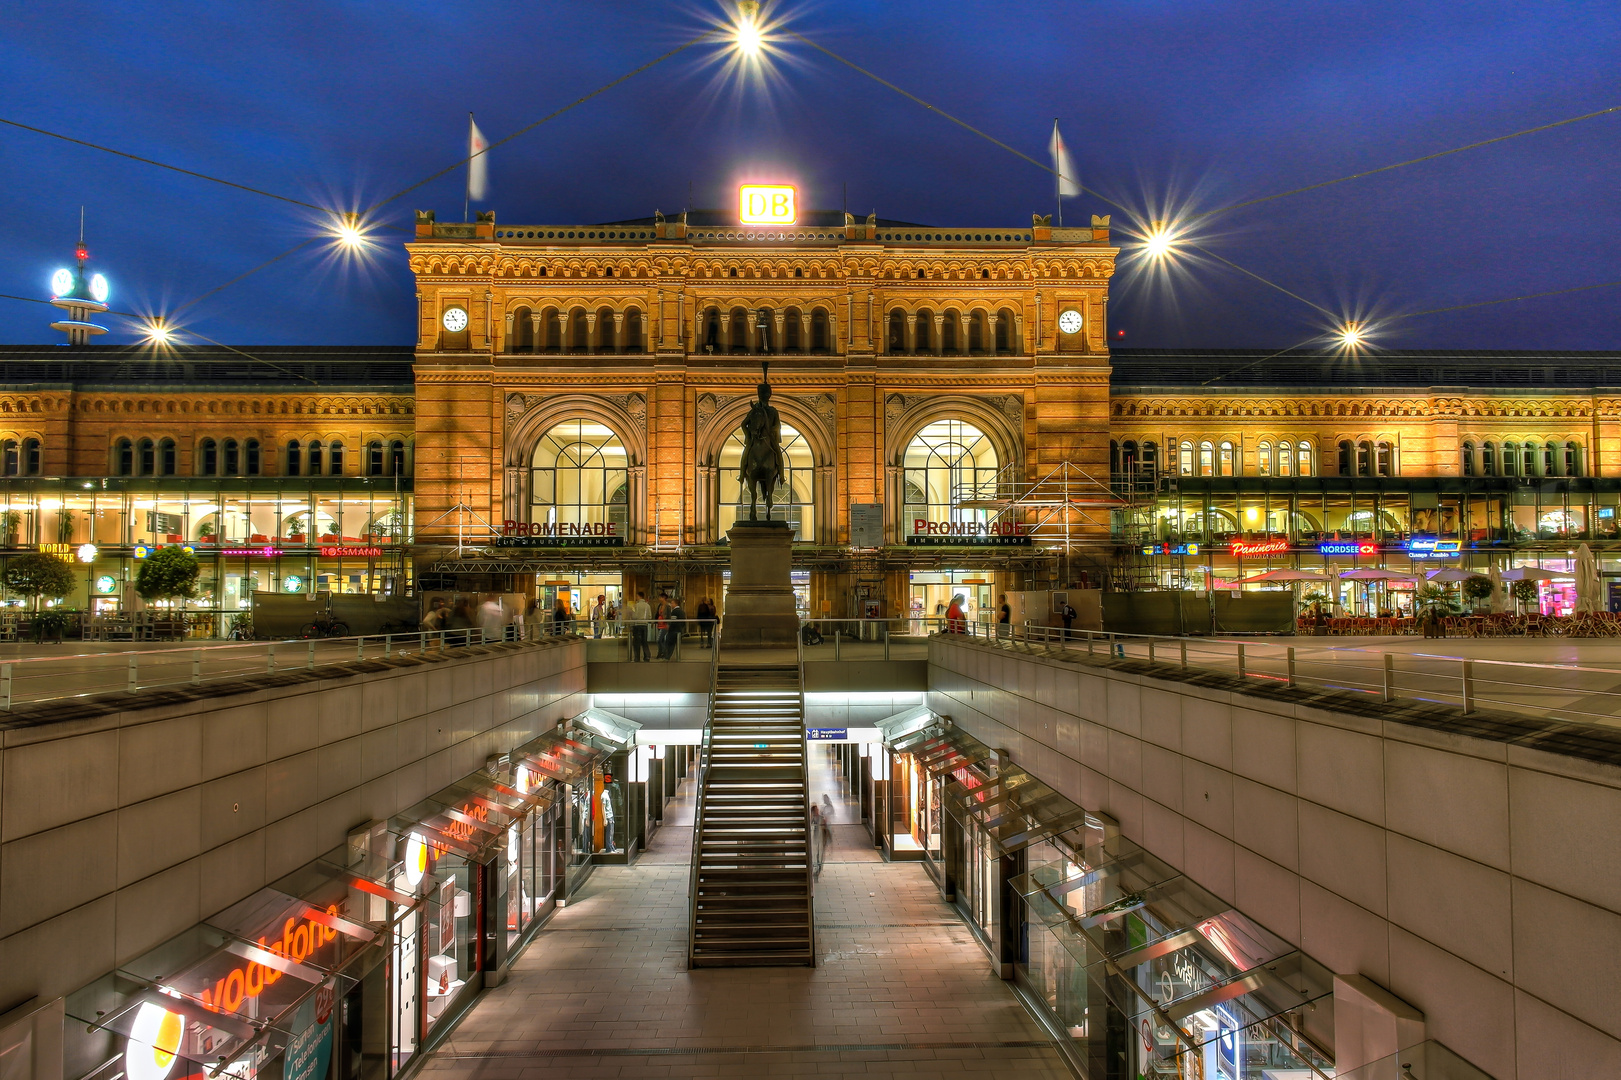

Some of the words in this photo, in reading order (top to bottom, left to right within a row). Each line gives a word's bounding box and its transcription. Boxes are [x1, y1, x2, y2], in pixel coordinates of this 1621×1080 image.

[748, 193, 789, 217] DB
[504, 519, 617, 536] PROMENADE
[914, 518, 1024, 535] PROMENADE
[39, 543, 69, 553] WORLD
[321, 547, 381, 556] ROSSMANN
[1231, 541, 1288, 556] Panineria
[1321, 545, 1359, 553] NORDSEE
[200, 904, 338, 1015] vodafone
[294, 1022, 331, 1072] Telefonieren
[295, 1057, 318, 1080] imsen
